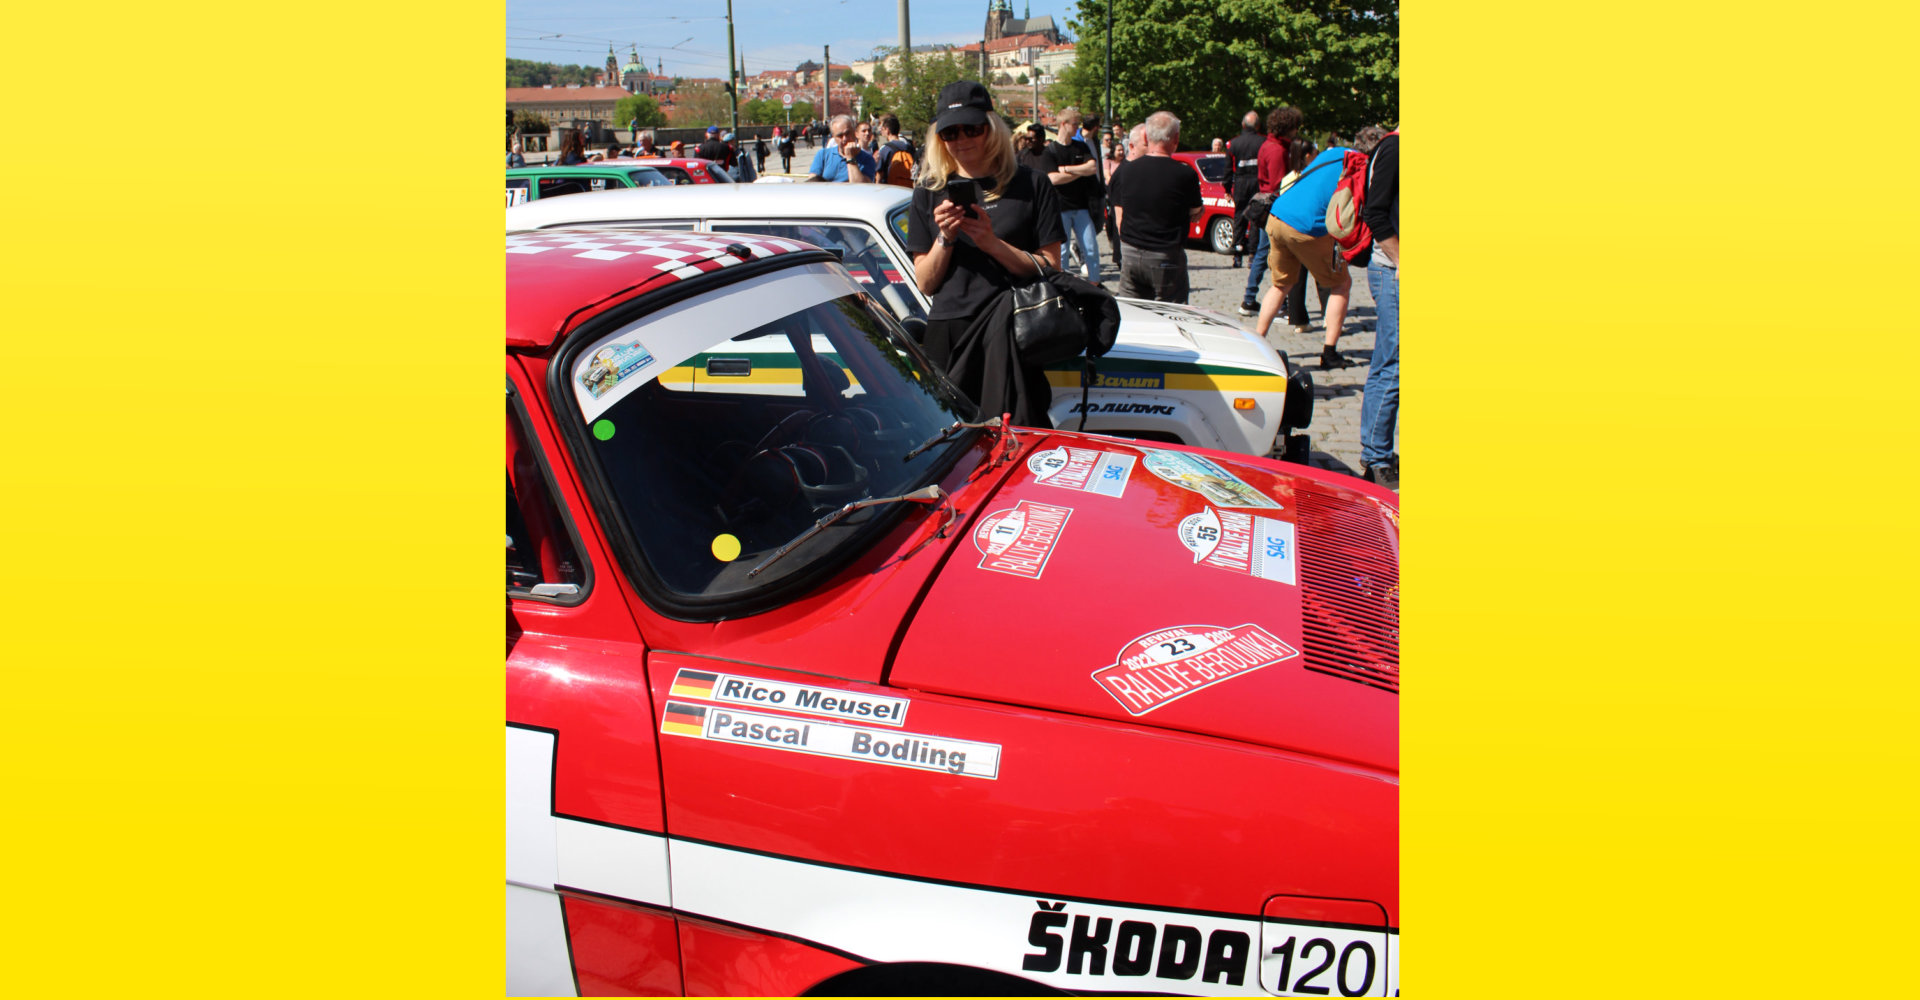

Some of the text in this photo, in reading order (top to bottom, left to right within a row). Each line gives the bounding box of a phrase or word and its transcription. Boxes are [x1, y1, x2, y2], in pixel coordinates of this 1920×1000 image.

[1095, 373, 1160, 388] Barum
[1045, 458, 1064, 468] 43
[1103, 465, 1123, 480] SAG
[978, 518, 1001, 539] REVIVAL
[990, 504, 1068, 575] RALLYE BEROUNKA
[995, 525, 1015, 535] 11
[1184, 525, 1198, 547] REVIVAL
[1197, 526, 1218, 541] 55
[1212, 531, 1250, 561] RALLYE
[1266, 536, 1285, 560] SAG
[1137, 628, 1193, 648] REVIVAL
[1122, 653, 1158, 671] 2022
[1160, 638, 1196, 656] 23
[1106, 630, 1291, 709] RALLYE BEROUNKA
[722, 679, 903, 720] Rico Meusel
[713, 714, 966, 775] Pascal Bodling
[1021, 900, 1376, 998] ŠKODA 120
